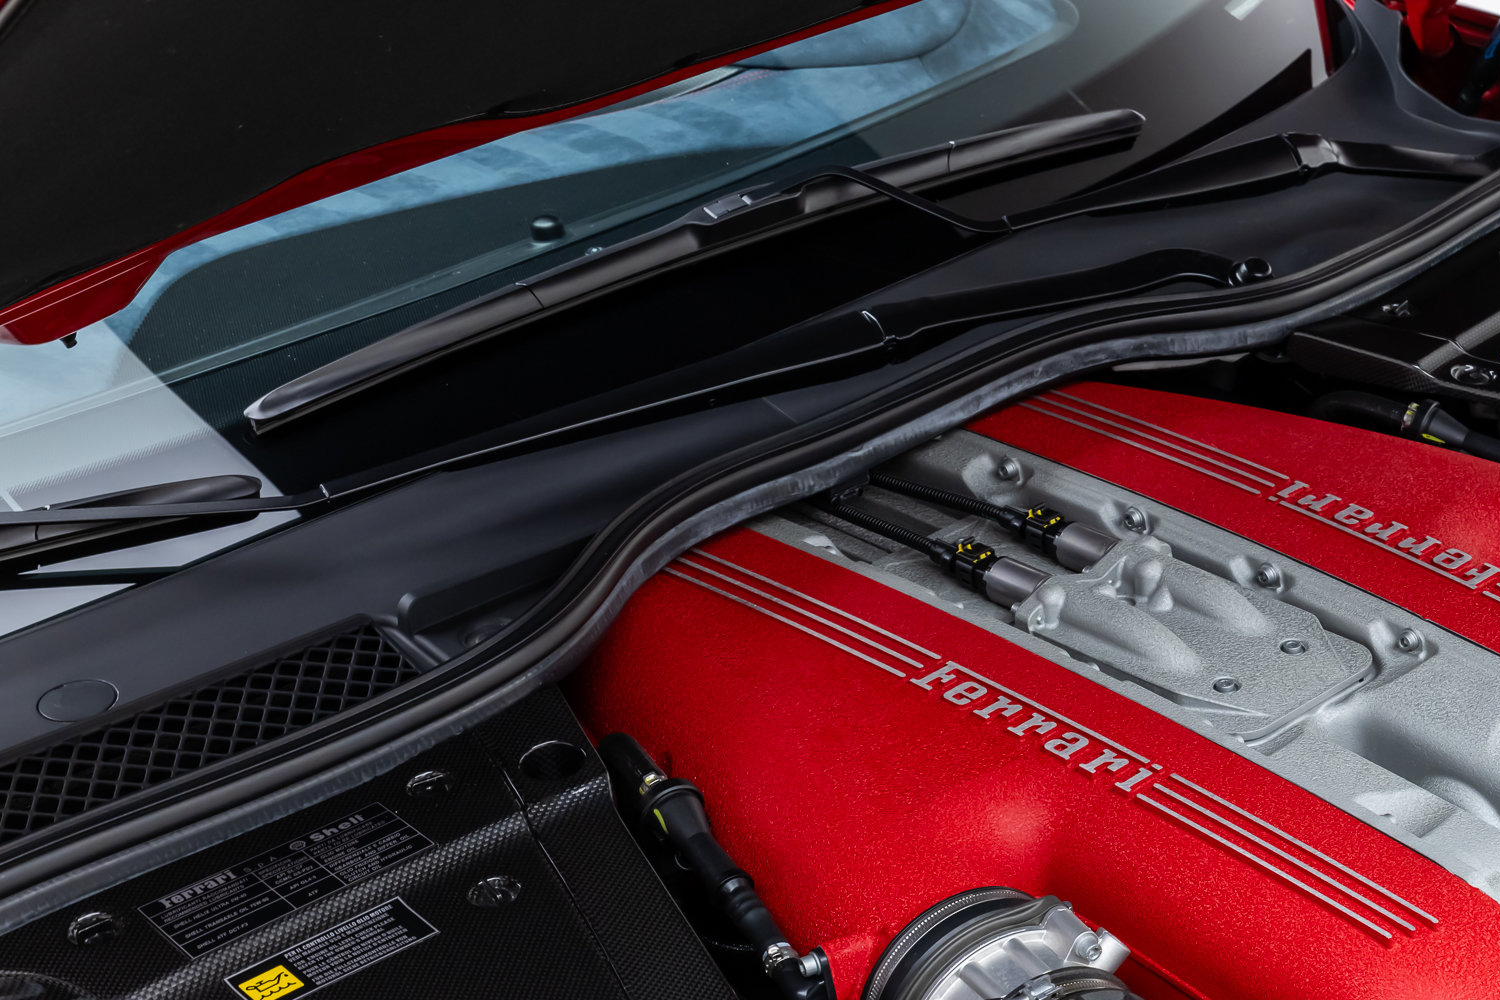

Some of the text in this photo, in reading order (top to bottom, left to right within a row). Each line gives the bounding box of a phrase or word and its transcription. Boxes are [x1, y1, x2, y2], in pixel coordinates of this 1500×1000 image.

[910, 660, 1163, 792] Ferrari
[310, 815, 364, 842] Shell
[160, 870, 236, 908] Ferrari
